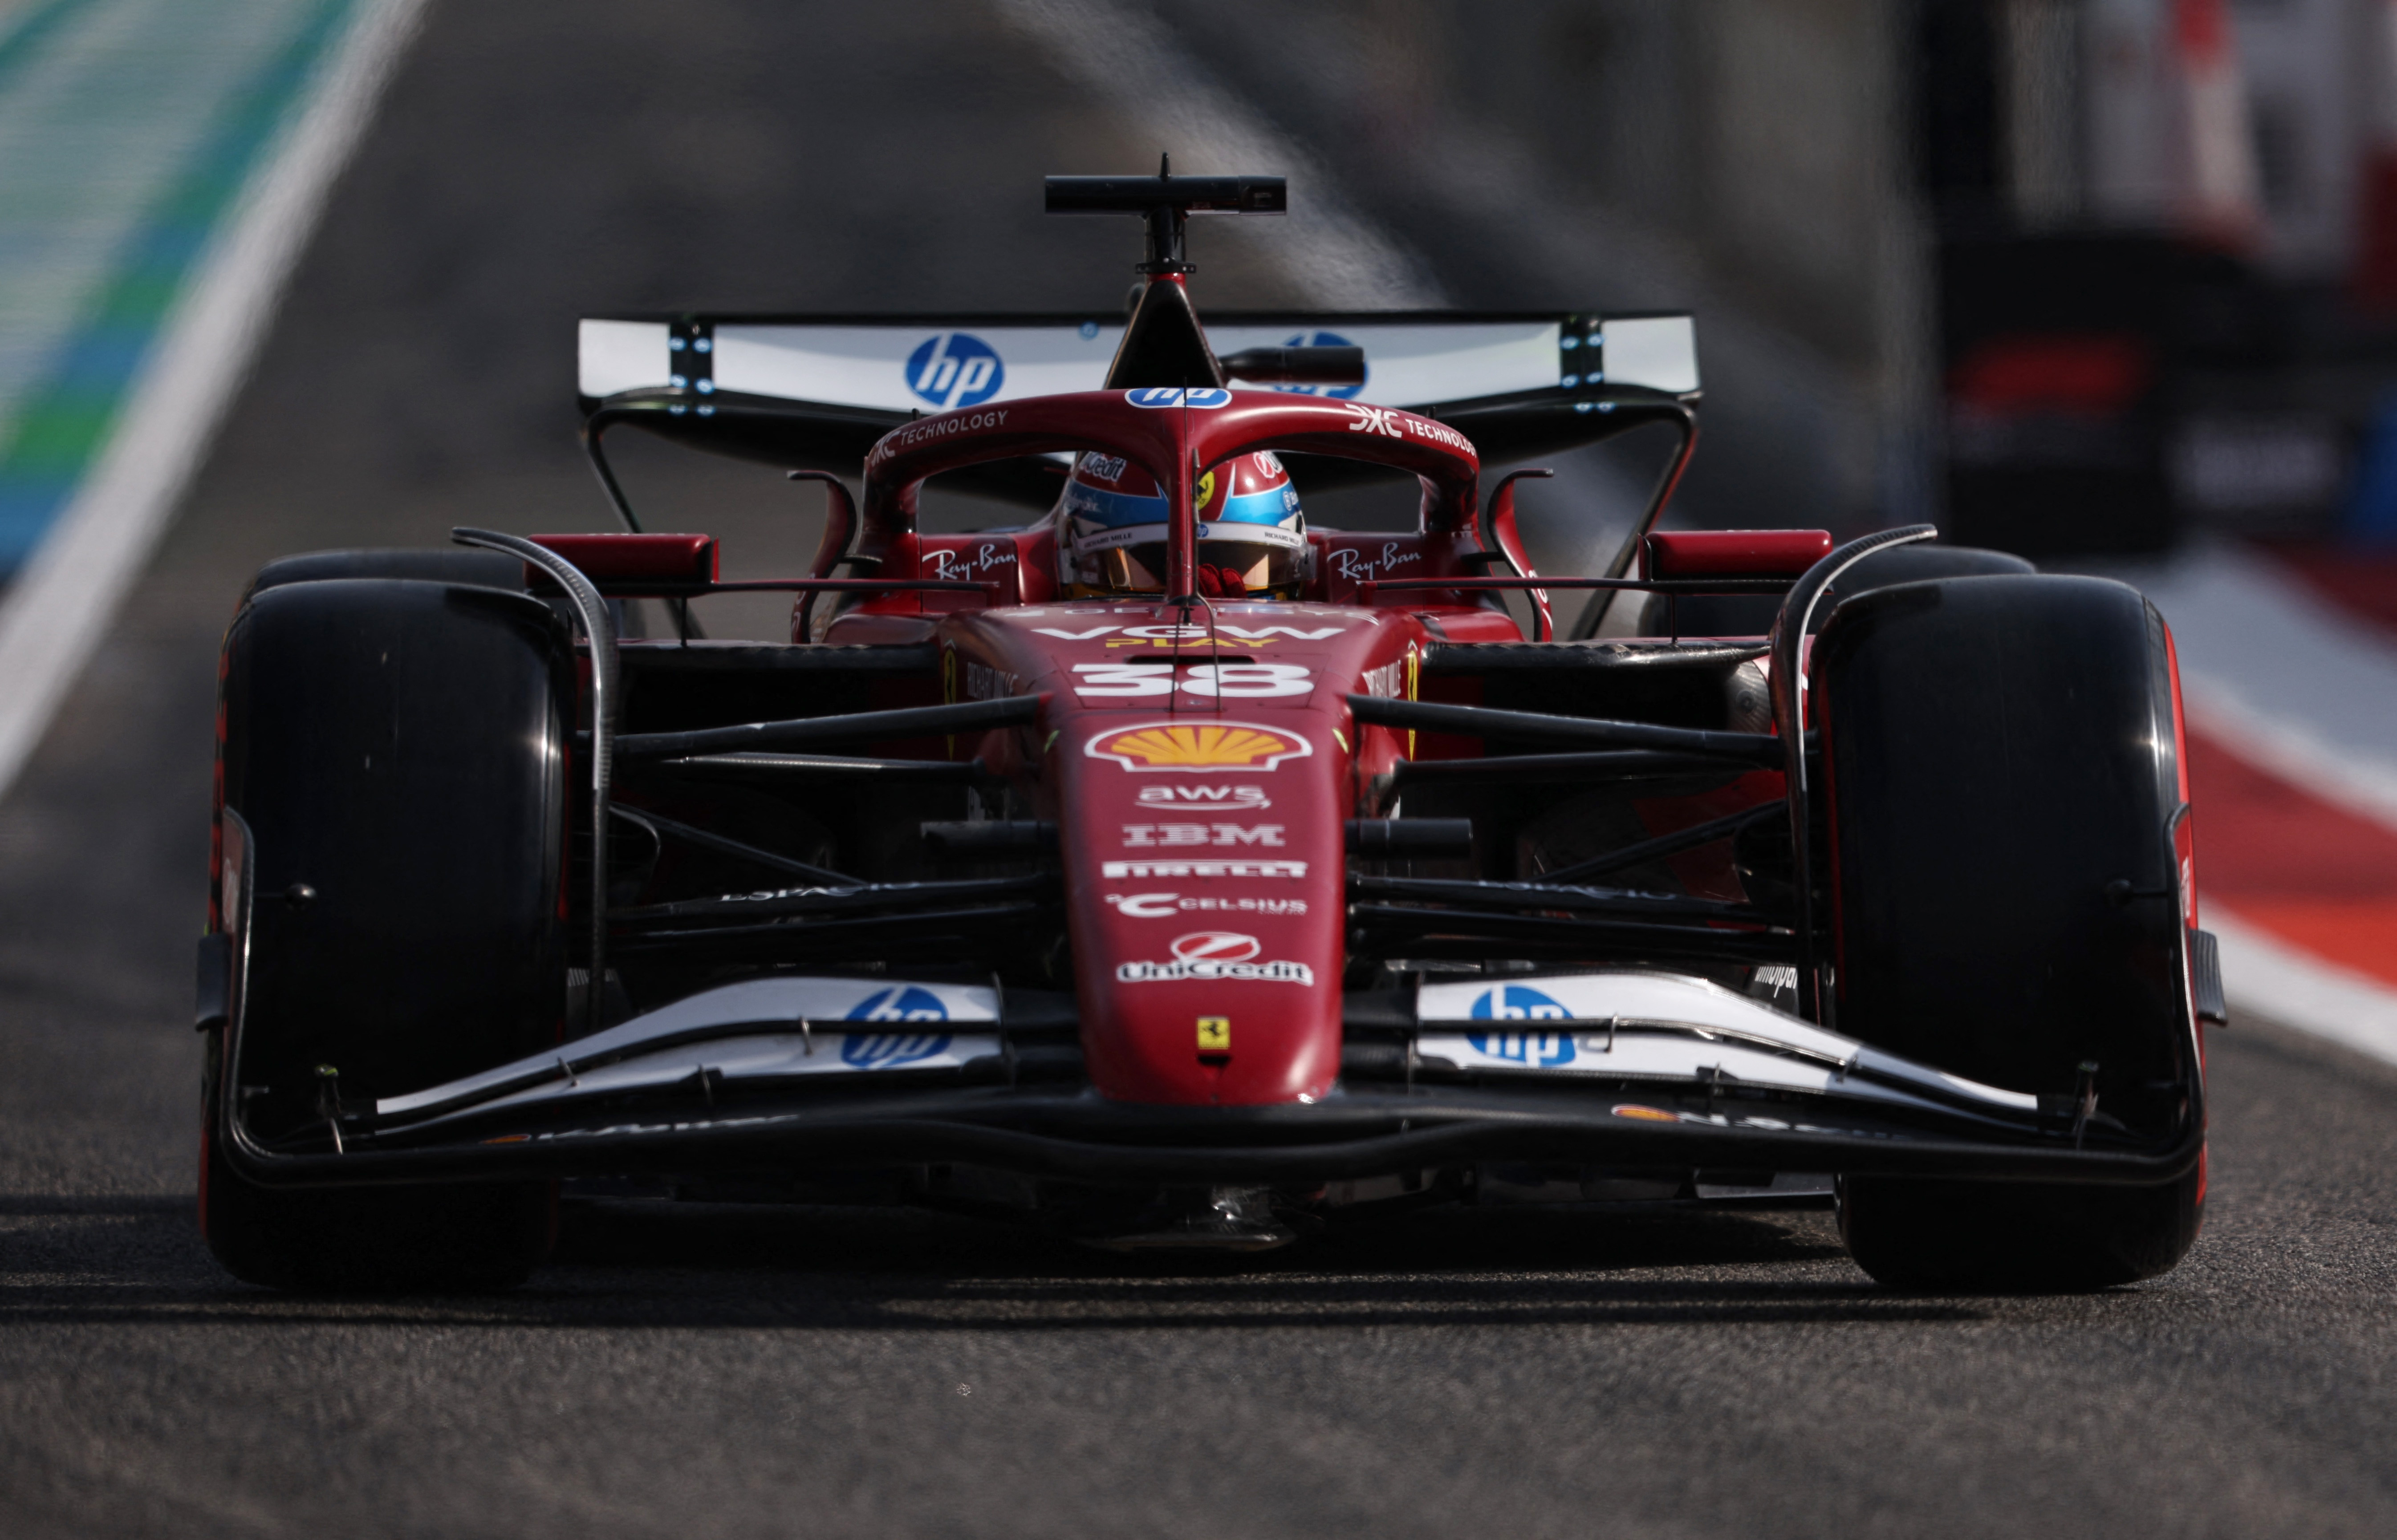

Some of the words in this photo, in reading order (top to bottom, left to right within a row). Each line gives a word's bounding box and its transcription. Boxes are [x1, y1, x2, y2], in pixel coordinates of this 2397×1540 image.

[914, 332, 997, 410] hp
[901, 409, 1009, 446] TECHNOLOGY
[1344, 403, 1403, 438] DXC
[1264, 531, 1288, 542] RICHARD
[1030, 625, 1347, 640] VGW
[1105, 638, 1281, 648] PLAY
[1072, 664, 1315, 697] 38
[1138, 785, 1265, 801] aws
[1121, 823, 1287, 847] IBM
[1117, 960, 1312, 985] UniCredit
[849, 985, 942, 1070] hp
[1484, 984, 1564, 1068] hp
